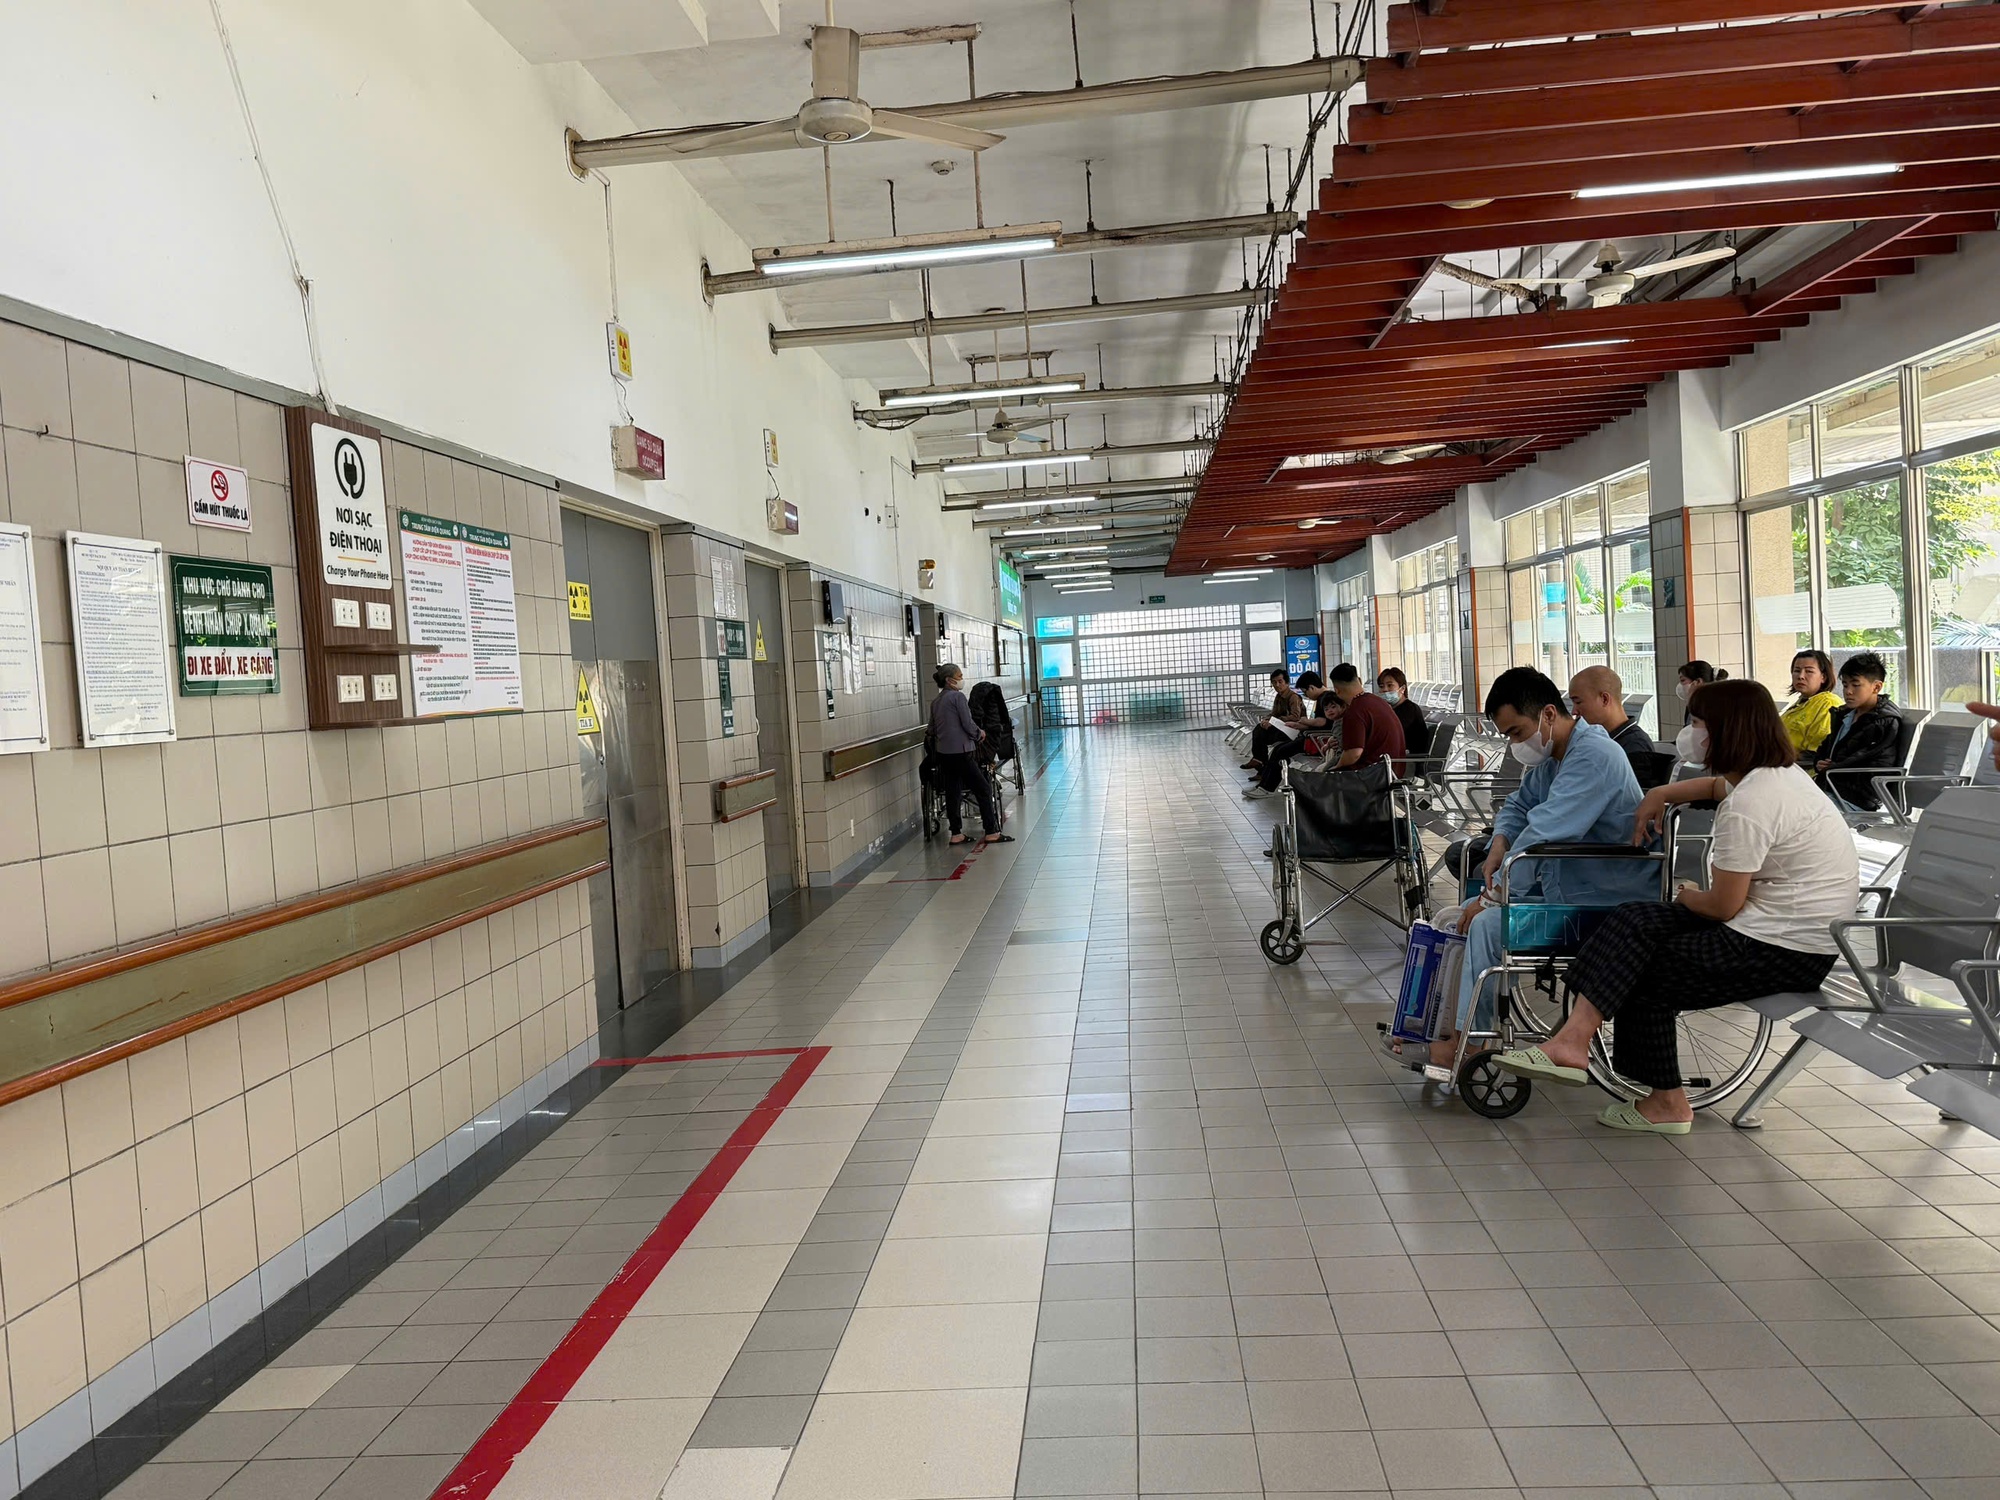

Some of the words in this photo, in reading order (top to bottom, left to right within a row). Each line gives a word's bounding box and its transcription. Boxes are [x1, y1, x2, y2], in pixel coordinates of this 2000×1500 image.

[194, 498, 208, 515] CẤM
[209, 502, 220, 516] HÚT
[222, 504, 240, 520] THUỐC
[241, 508, 248, 521] LÁ
[336, 507, 353, 524] NƠI
[355, 510, 373, 531] SẠC
[330, 530, 353, 552] ĐIỆN
[354, 535, 382, 557] THOẠI
[327, 565, 346, 578] Charge
[347, 567, 360, 577] Your
[360, 569, 376, 579] Phone
[377, 571, 389, 580] Here
[183, 576, 198, 594] KHU
[200, 577, 214, 599] VỰC
[216, 576, 231, 597] CHỜ
[232, 578, 250, 598] DÀNH
[252, 582, 265, 599] CHO
[579, 586, 588, 597] TIA
[582, 600, 587, 610] X
[183, 605, 203, 640] BỆNH
[204, 606, 224, 635] NHÂN
[225, 612, 242, 640] CHỤP
[187, 656, 198, 675] ĐI
[200, 656, 212, 675] XE
[215, 648, 235, 677] ĐẨY,
[237, 656, 248, 675] XE
[250, 652, 273, 674] CÁNG
[1289, 659, 1303, 673] ĐỒ
[1305, 660, 1318, 672] ĂN
